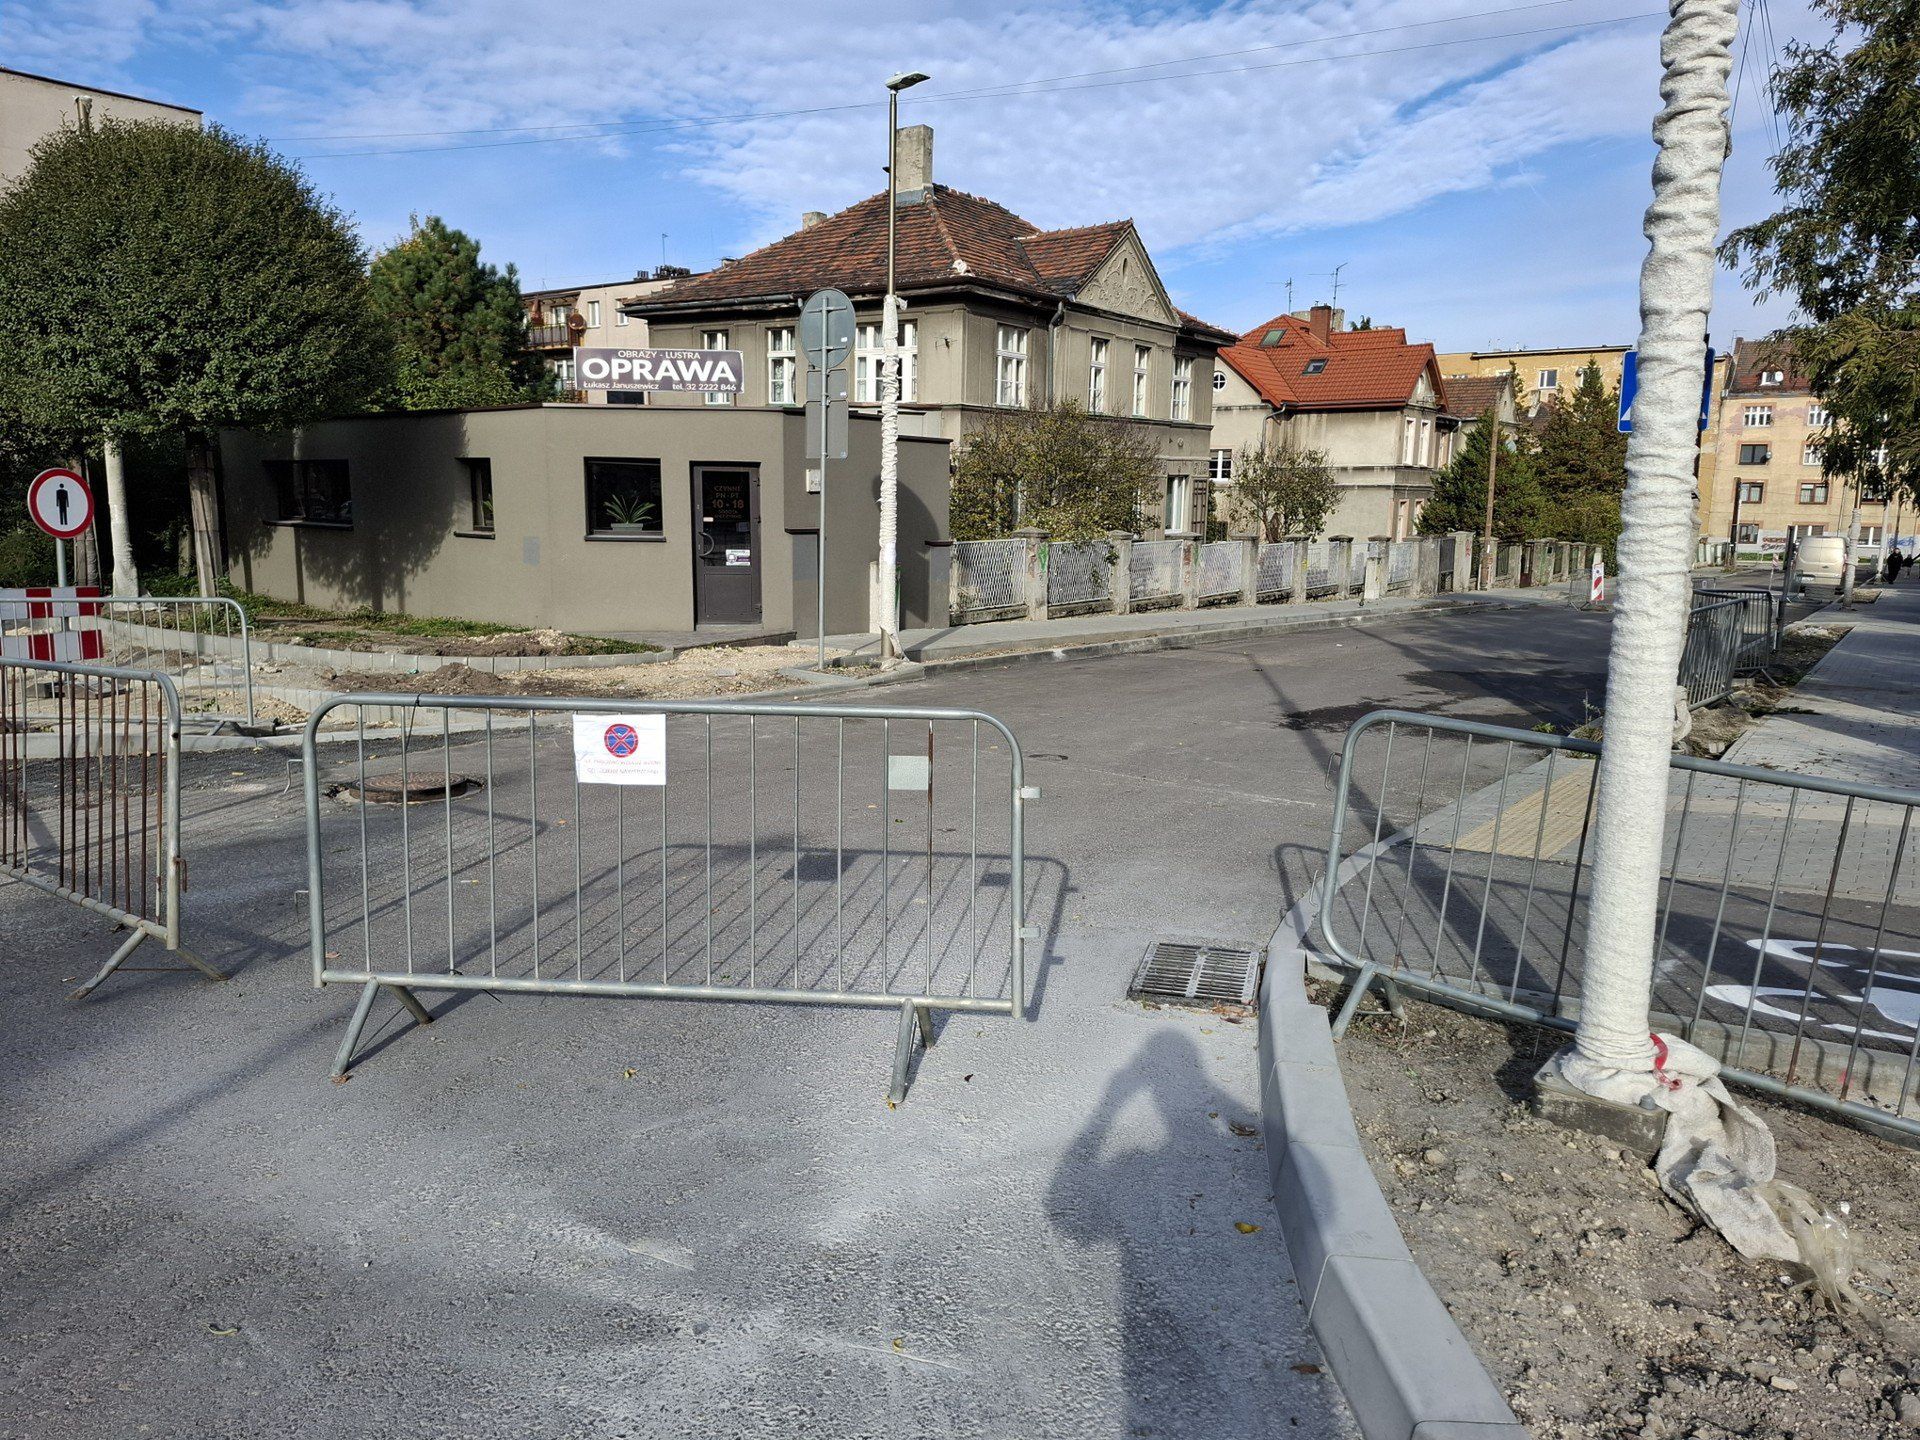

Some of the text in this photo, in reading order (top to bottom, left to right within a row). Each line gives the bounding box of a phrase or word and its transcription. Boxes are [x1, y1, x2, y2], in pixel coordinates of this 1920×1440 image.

[618, 350, 658, 359] OBRAZY
[665, 351, 700, 360] LUSTRA
[581, 357, 737, 382] OPRAWA
[583, 381, 610, 389] Łukasz
[612, 382, 659, 390] Januszewicz
[685, 383, 696, 391] 32
[712, 499, 724, 509] 10
[732, 499, 744, 509] 18
